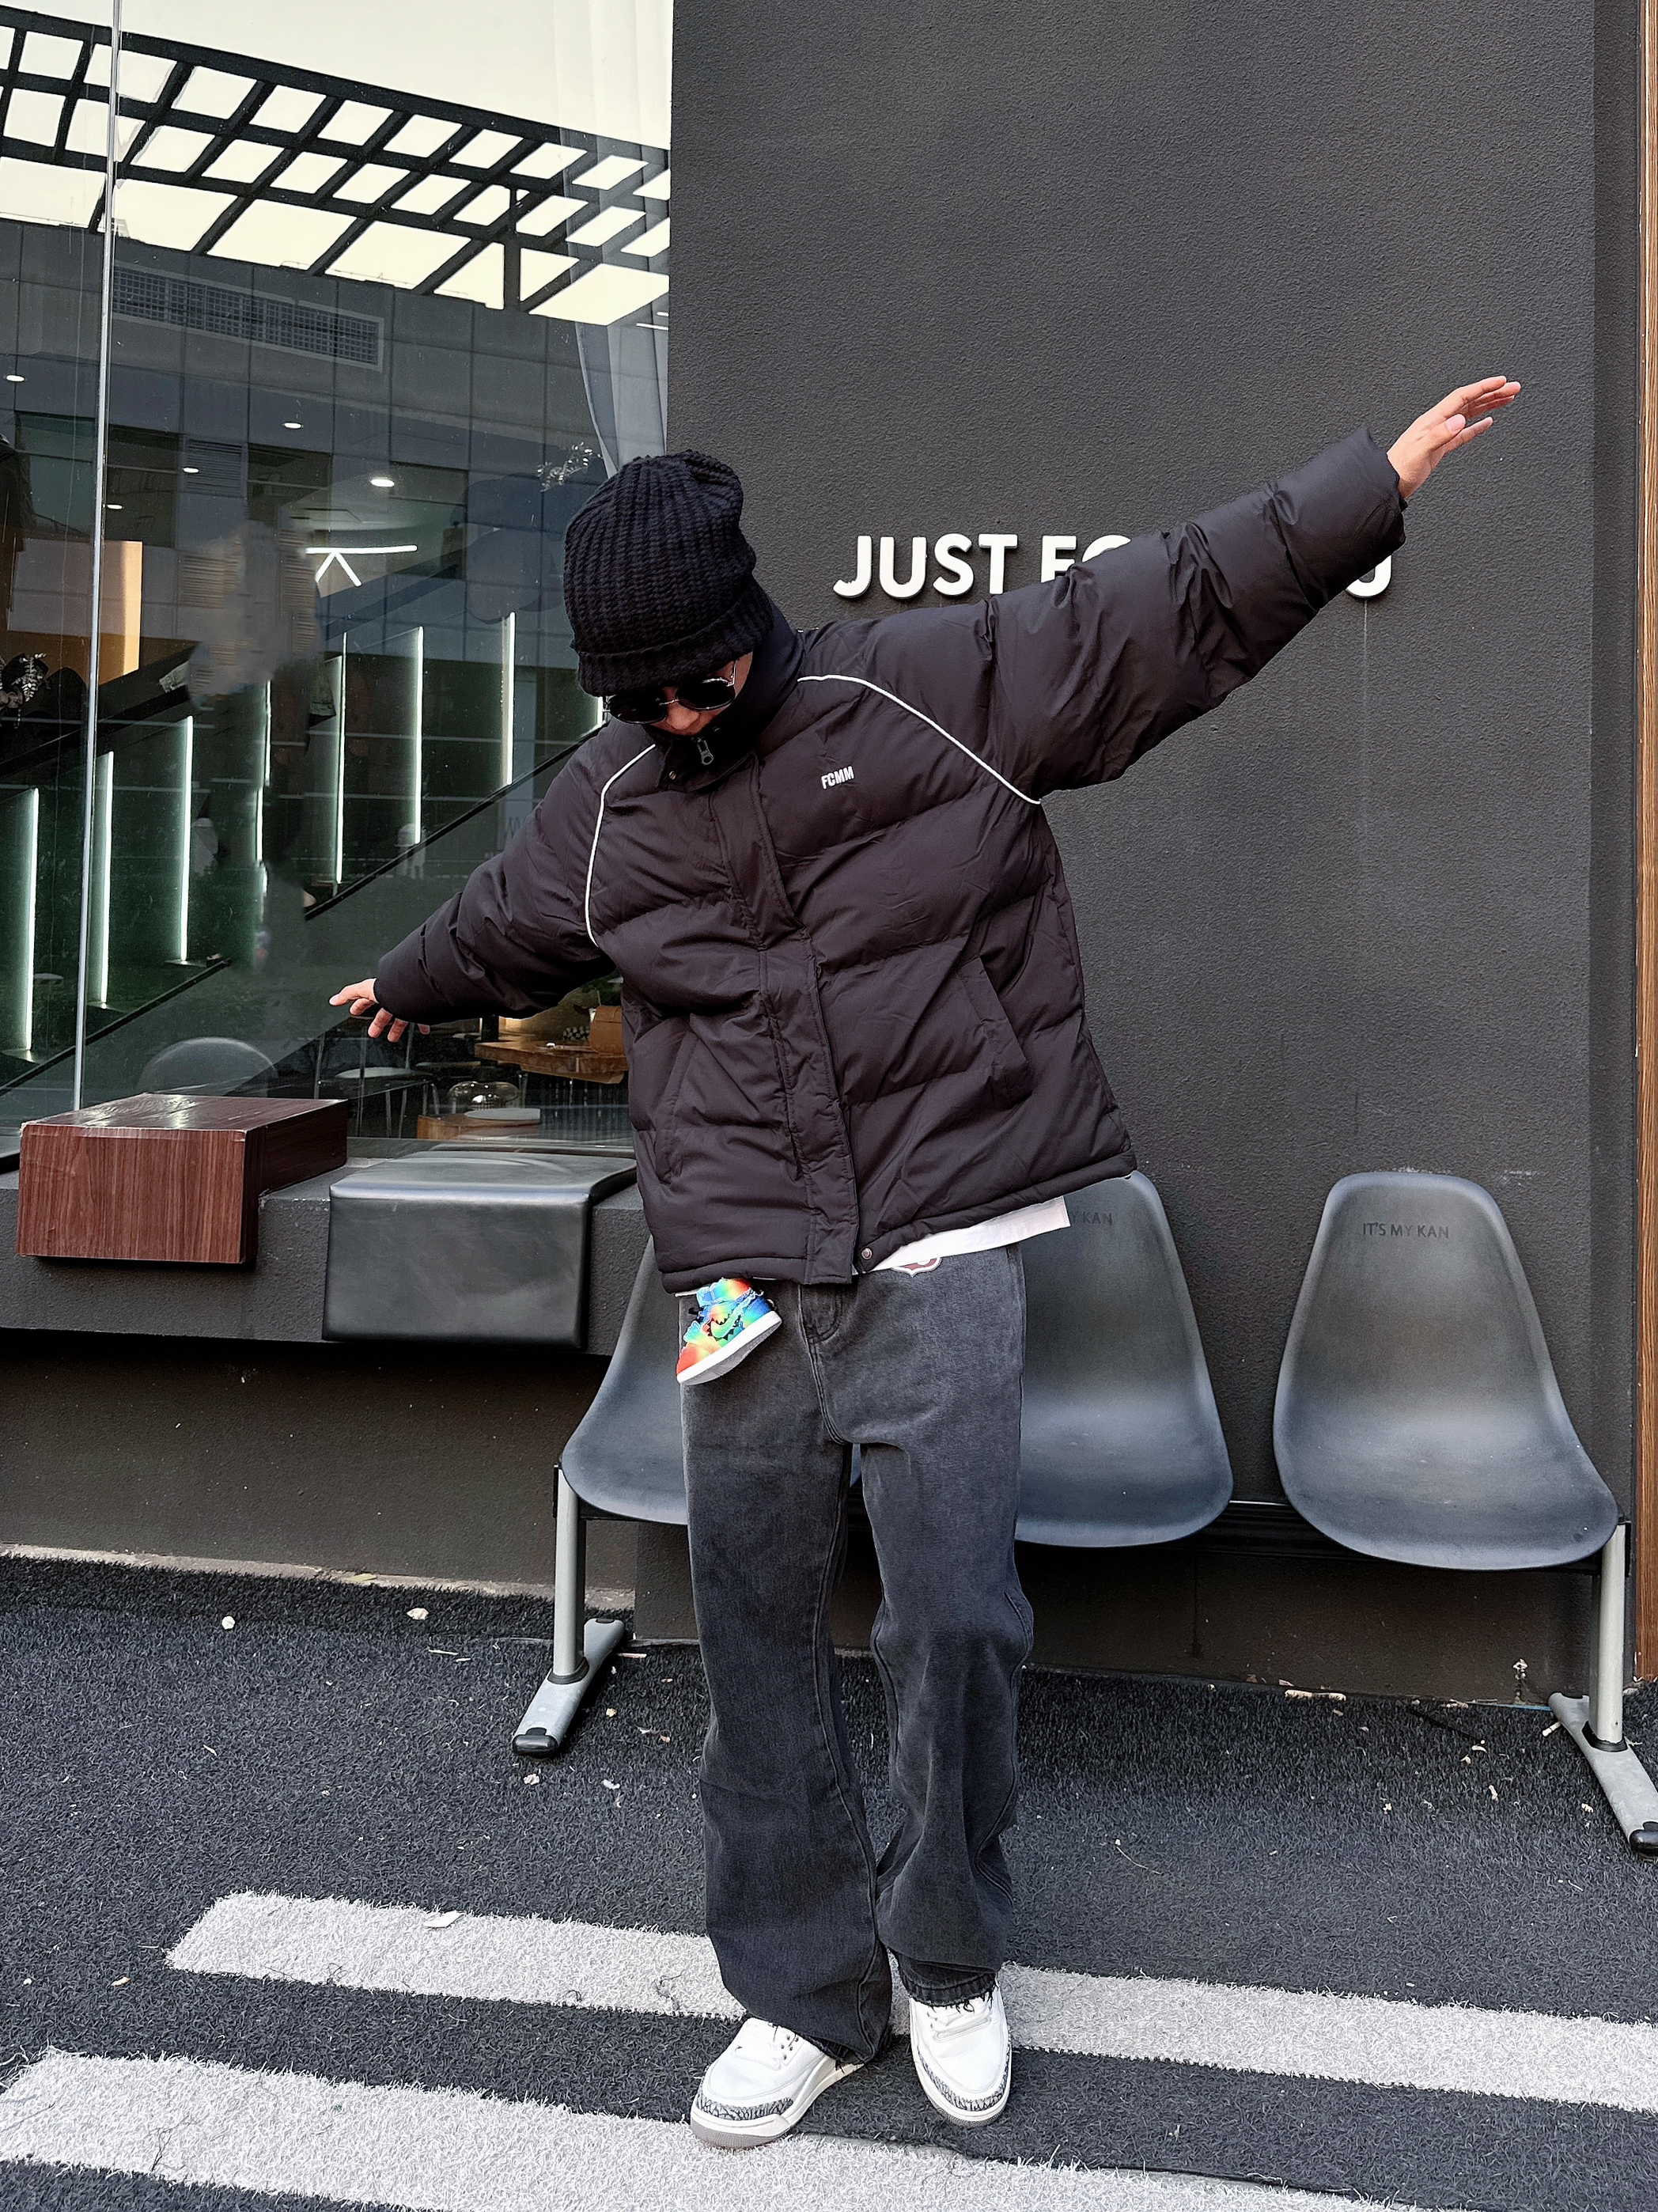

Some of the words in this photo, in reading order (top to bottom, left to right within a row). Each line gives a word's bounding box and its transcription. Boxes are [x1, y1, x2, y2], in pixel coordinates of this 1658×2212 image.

[833, 533, 1018, 599] JUST
[821, 765, 854, 790] FCMM
[1362, 1222, 1387, 1236] IT'S
[1390, 1224, 1413, 1237] MY
[1417, 1225, 1449, 1239] KAN
